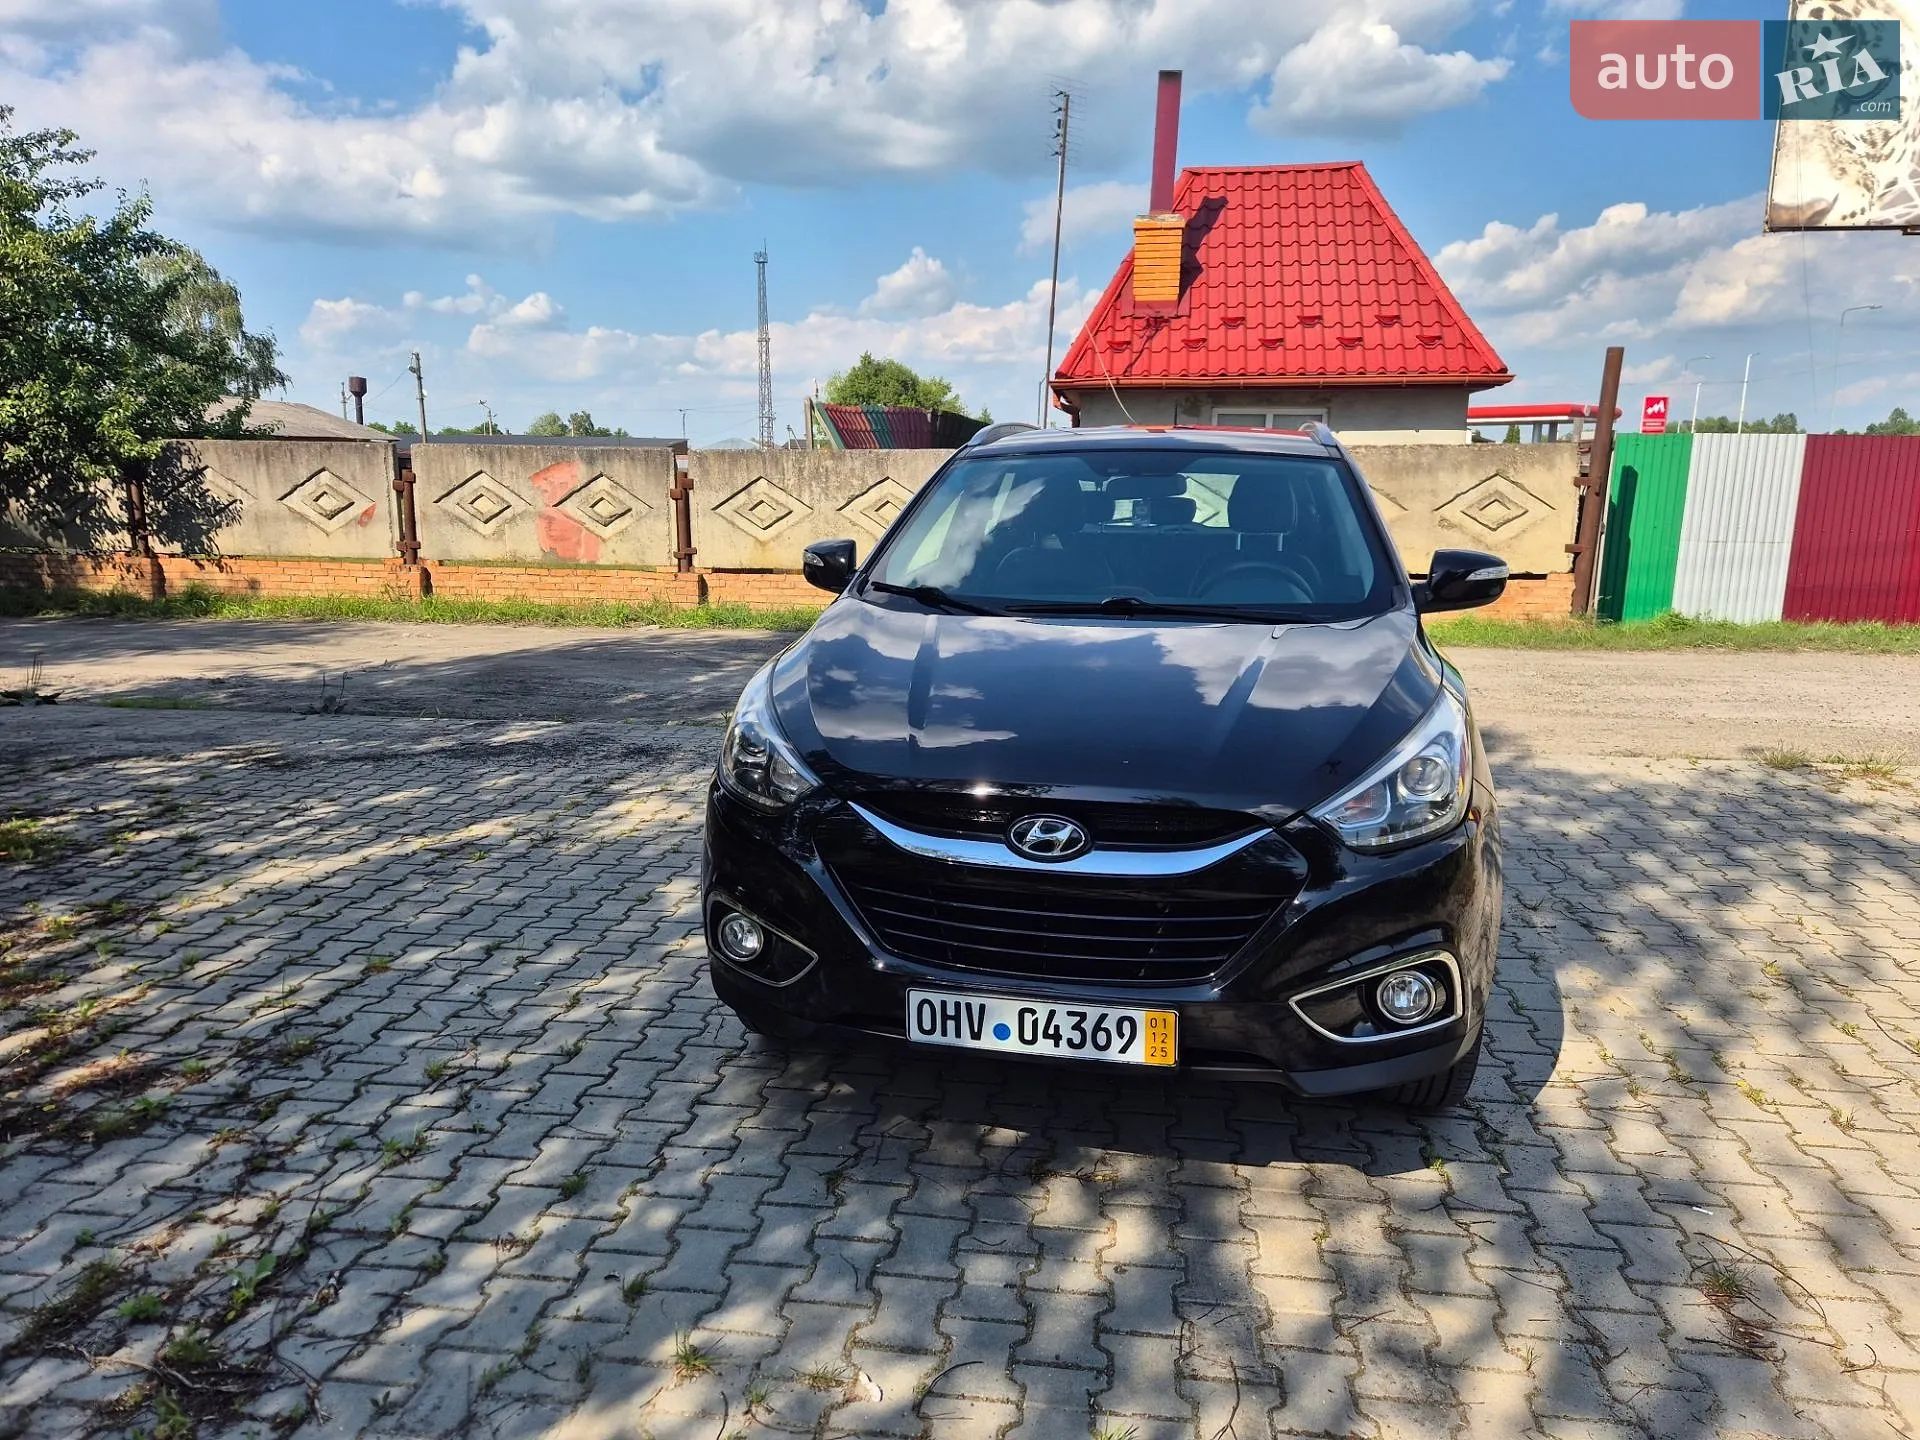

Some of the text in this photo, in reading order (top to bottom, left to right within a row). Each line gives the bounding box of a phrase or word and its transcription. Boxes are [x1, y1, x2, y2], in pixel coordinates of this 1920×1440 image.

[916, 998, 1138, 1055] OHV 04369
[1150, 1017, 1167, 1029] 01
[1151, 1031, 1168, 1044] 12
[1150, 1046, 1168, 1058] 25
